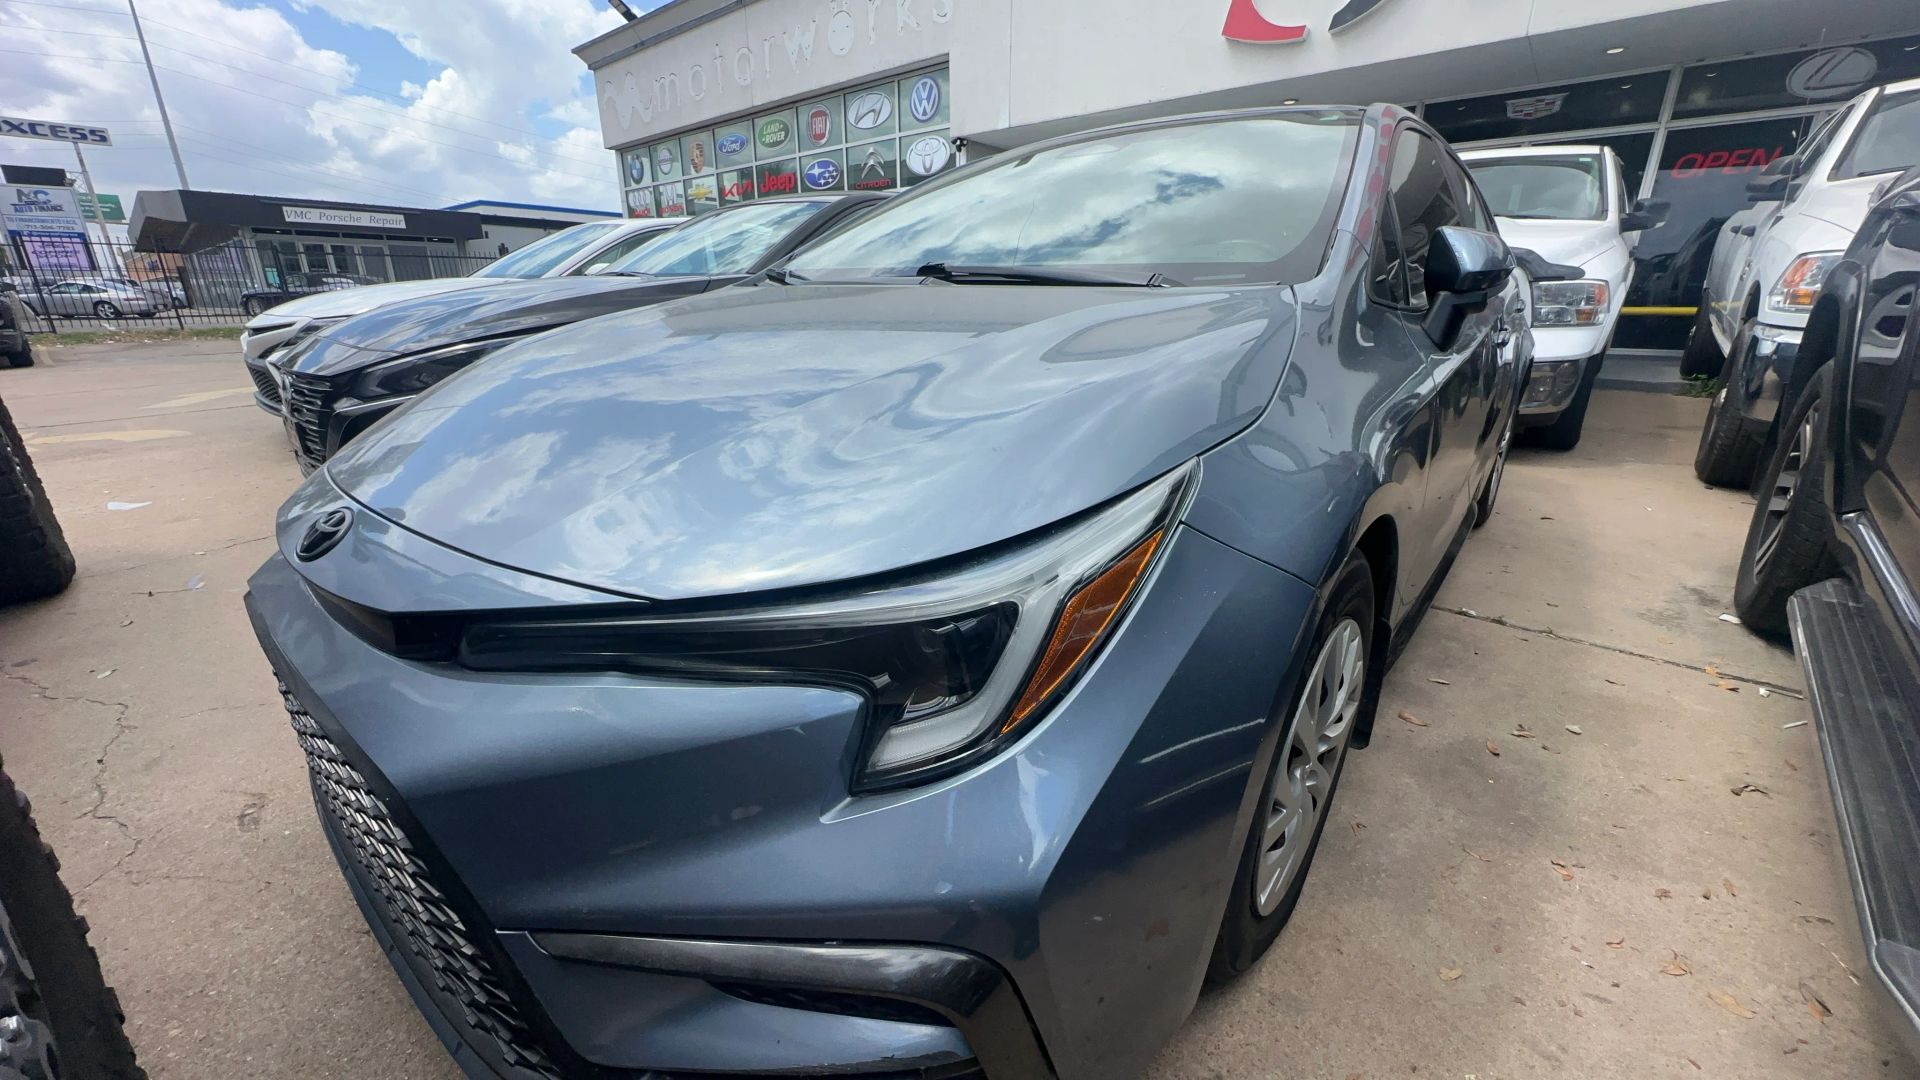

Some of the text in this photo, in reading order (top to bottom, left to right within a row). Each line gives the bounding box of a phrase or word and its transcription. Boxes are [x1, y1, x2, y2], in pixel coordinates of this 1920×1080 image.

[0, 119, 108, 142] XCESS
[763, 122, 780, 134] LAND
[812, 116, 826, 134] FIAT
[722, 137, 741, 152] Ford
[765, 131, 785, 143] ROVER
[1671, 145, 1783, 179] OPEN
[760, 171, 796, 193] Jeep
[285, 210, 403, 227] VMC Porsche Repair
